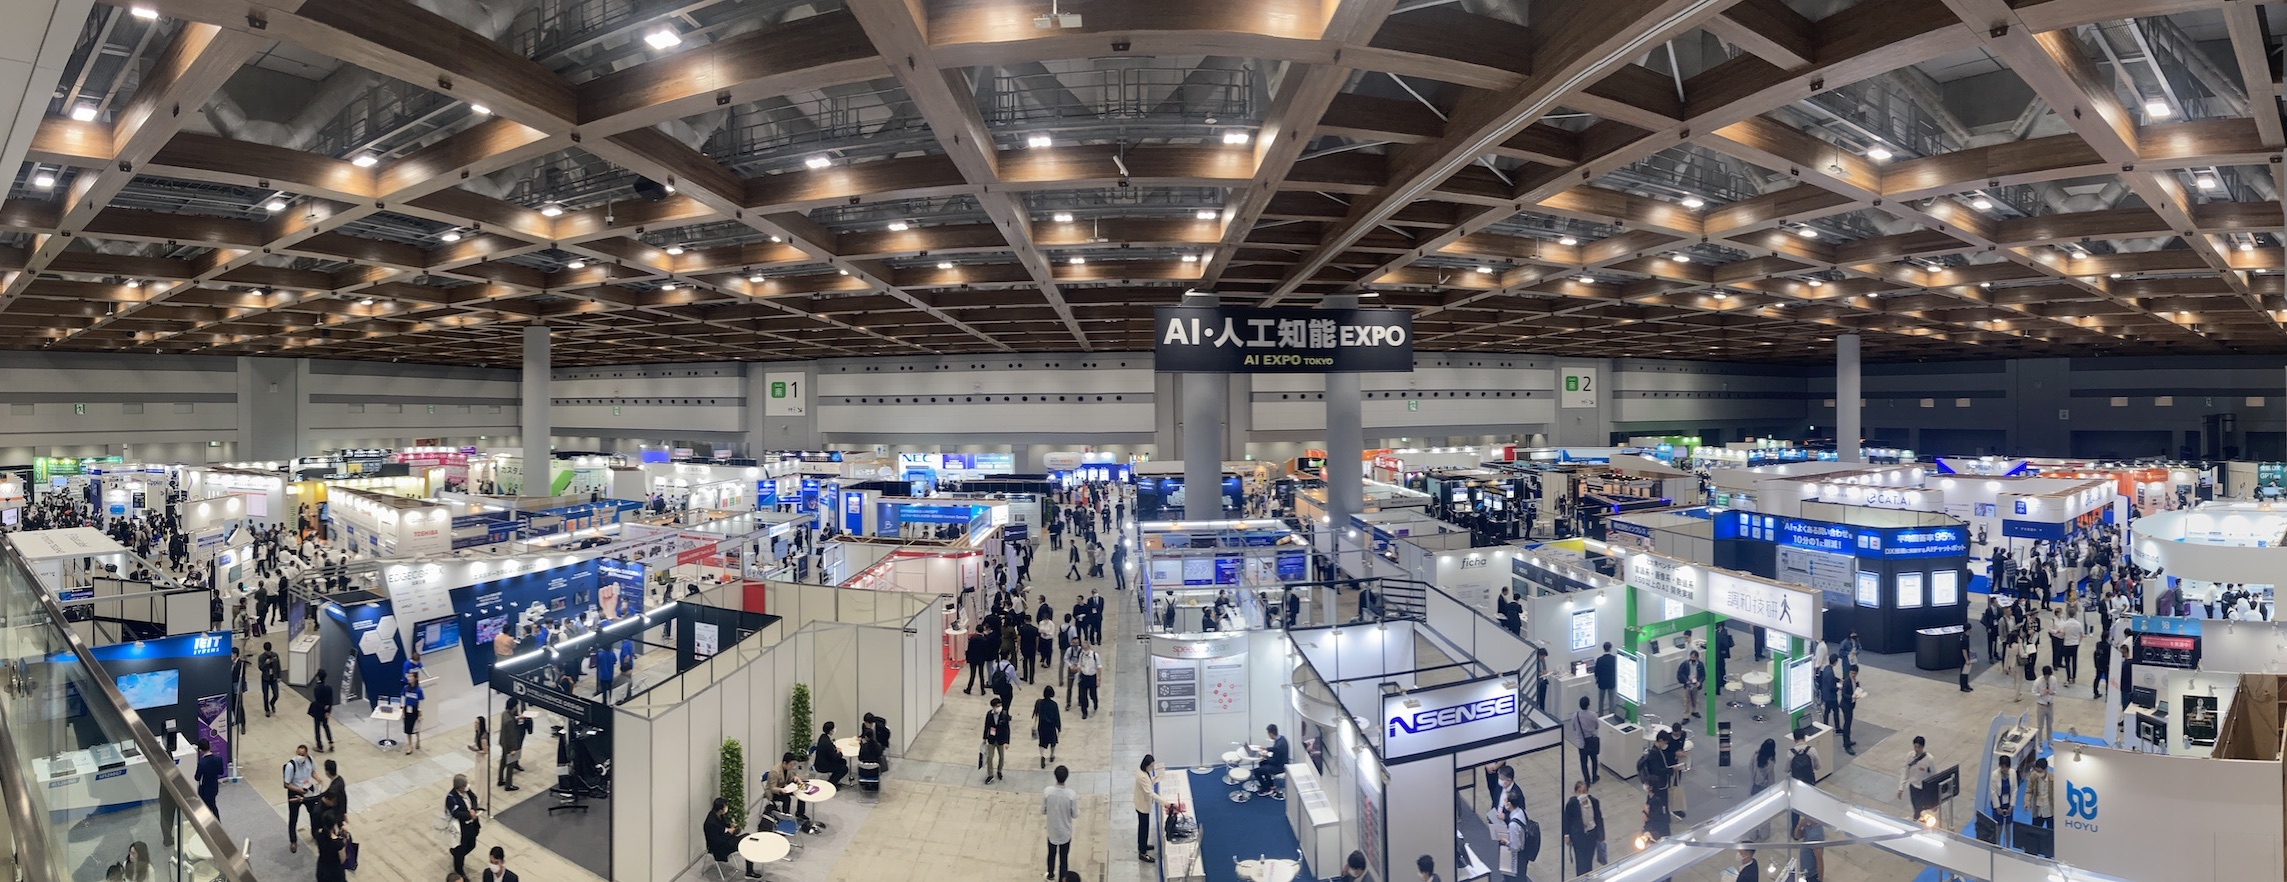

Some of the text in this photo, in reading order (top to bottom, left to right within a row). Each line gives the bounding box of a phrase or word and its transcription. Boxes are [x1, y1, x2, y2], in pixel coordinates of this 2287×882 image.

[1244, 354, 1334, 366] AI EXPO TOKYO
[791, 381, 797, 398] 1
[1583, 376, 1592, 391] 2
[903, 454, 932, 463] NEC
[413, 529, 438, 538] TOSHIBA
[1460, 557, 1487, 570] ficha
[2064, 819, 2099, 833] HOYU
